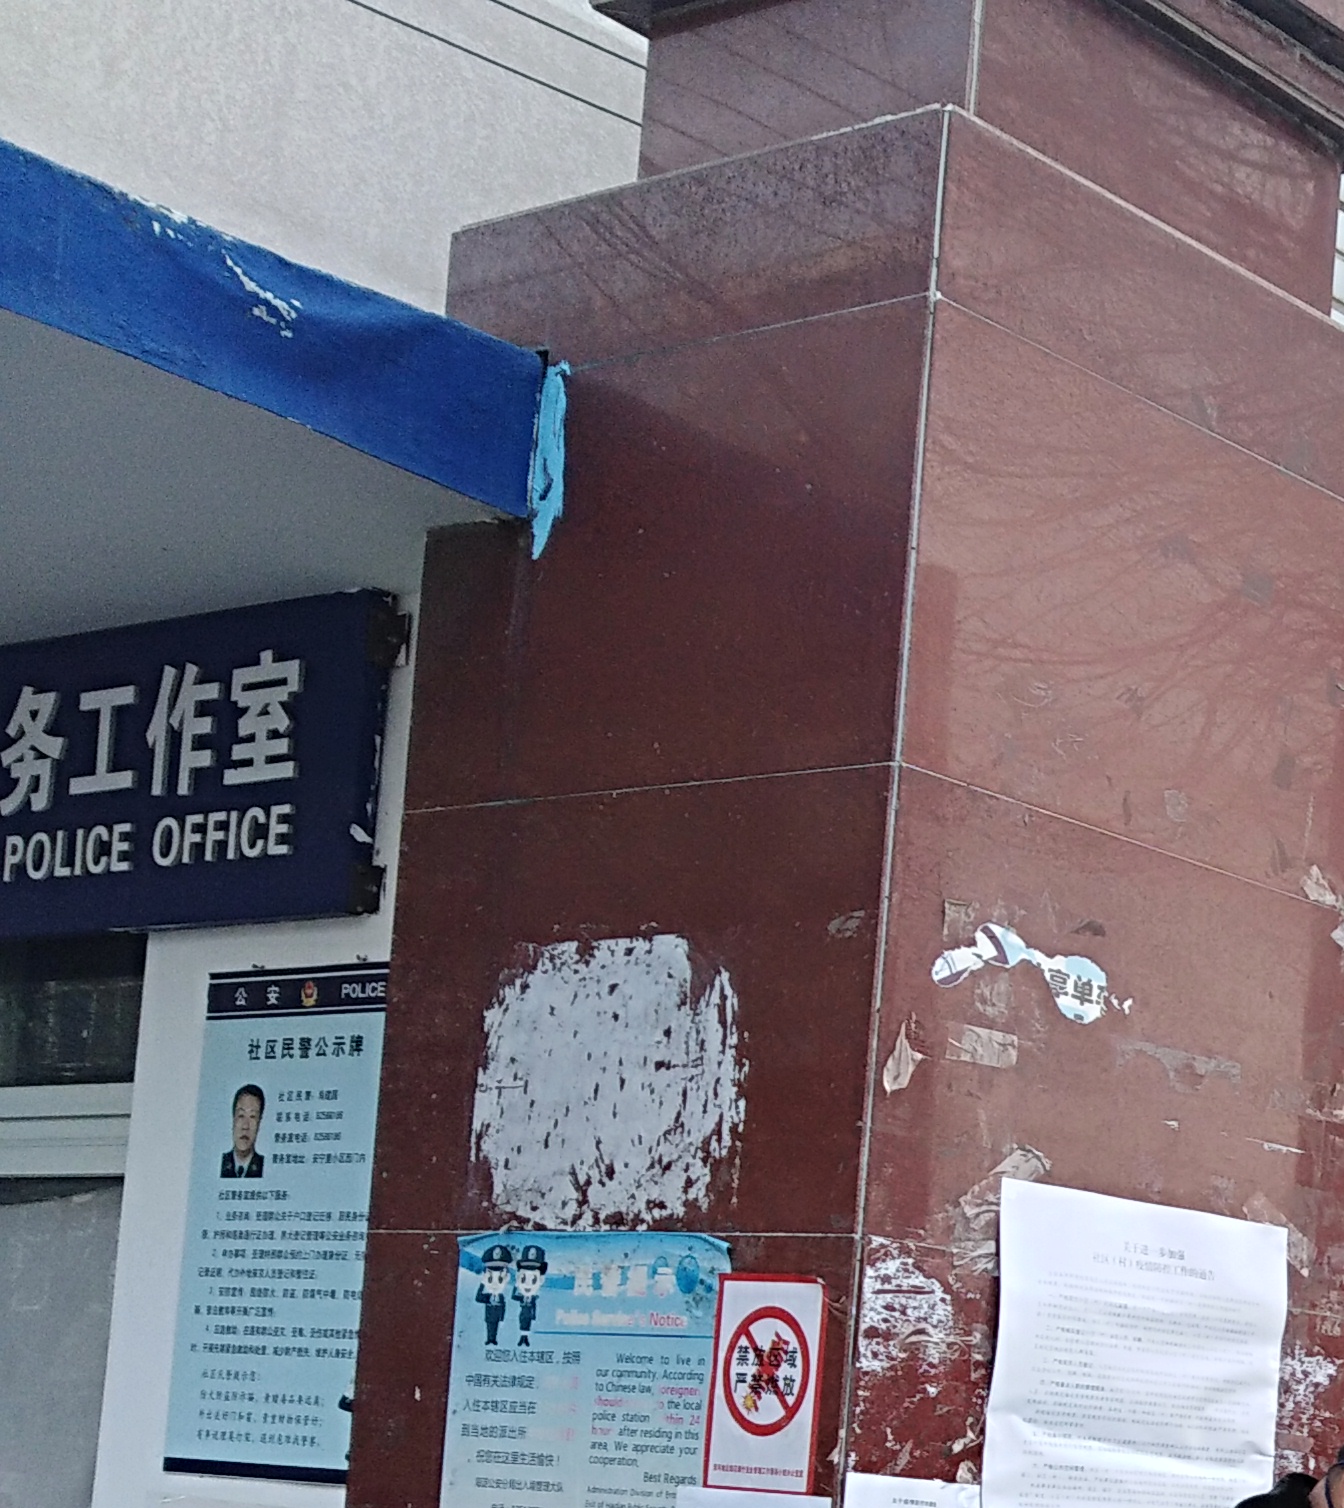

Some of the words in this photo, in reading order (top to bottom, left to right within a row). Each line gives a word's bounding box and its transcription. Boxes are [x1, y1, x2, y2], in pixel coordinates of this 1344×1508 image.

[0, 648, 304, 816] 务工作室
[3, 822, 135, 883] POLICE
[151, 803, 295, 868] OFFICE
[341, 981, 387, 999] POLICE
[247, 1034, 364, 1061] 社区民警公示牌
[616, 1353, 654, 1365] Welcome
[660, 1355, 670, 1365] to
[676, 1354, 691, 1366] live
[661, 1369, 705, 1384] According
[595, 1381, 604, 1392] to
[605, 1381, 637, 1393] Chinese
[667, 1400, 681, 1410] the
[683, 1400, 702, 1411] local
[591, 1410, 616, 1423] police
[621, 1412, 651, 1423] station
[618, 1426, 639, 1438] after
[640, 1428, 673, 1442] residing
[674, 1428, 683, 1440] in
[684, 1429, 700, 1441] this
[614, 1441, 629, 1452] We
[631, 1443, 675, 1455] appreciate
[678, 1446, 698, 1458] your
[643, 1471, 662, 1483] Best
[663, 1473, 697, 1488] Regards
